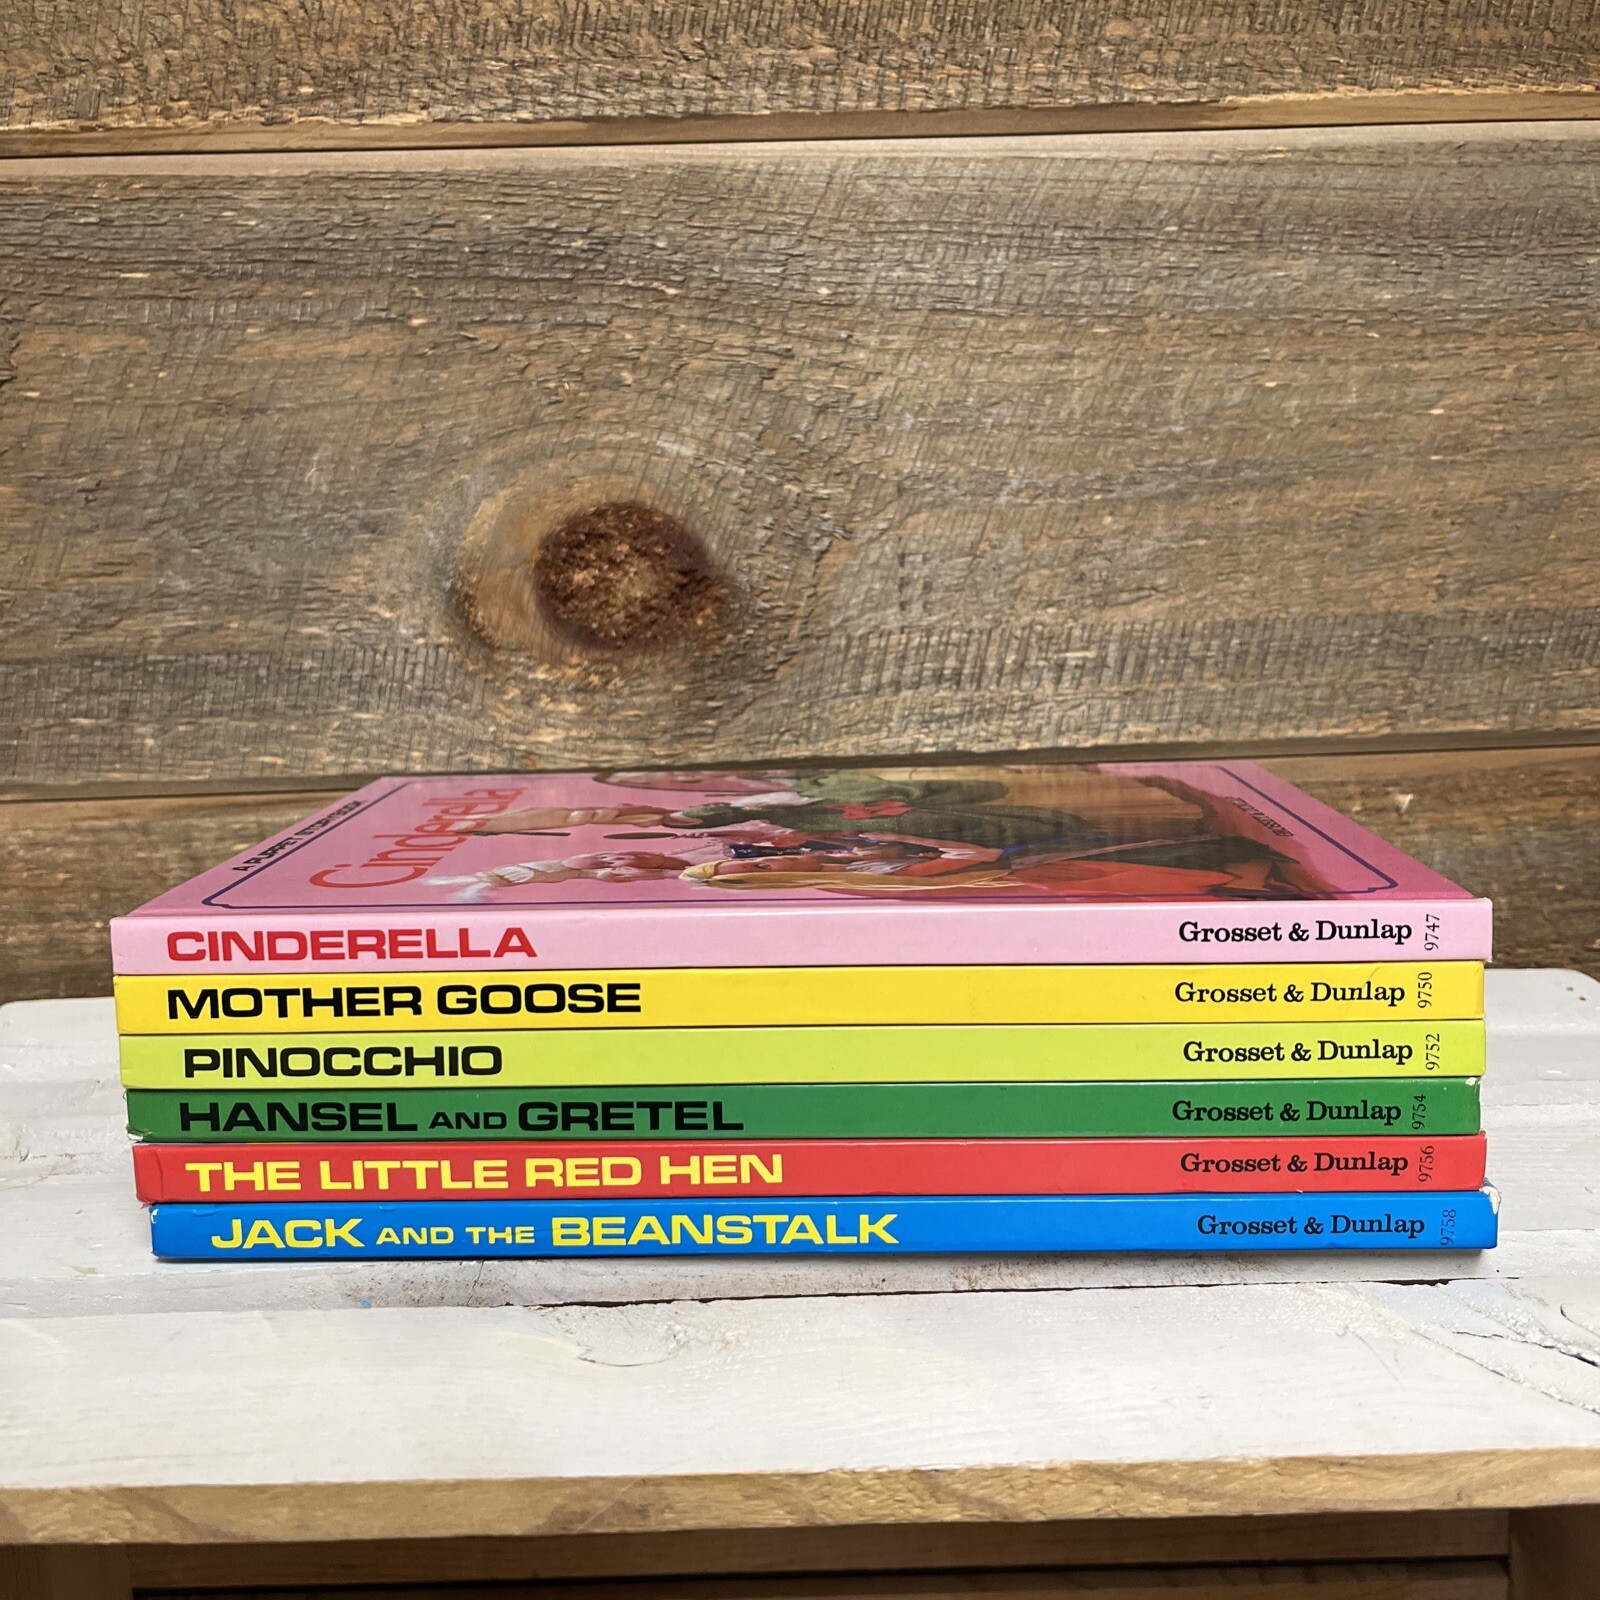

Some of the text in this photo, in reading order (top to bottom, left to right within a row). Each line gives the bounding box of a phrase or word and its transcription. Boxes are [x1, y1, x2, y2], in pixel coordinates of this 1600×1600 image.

[243, 836, 303, 864] PUPPET
[309, 788, 526, 888] Cinderella
[232, 864, 255, 872] A
[167, 927, 537, 961] CINDERELLA
[1179, 919, 1412, 946] Grosset & Dunlap
[1424, 913, 1440, 951] 9747
[168, 982, 641, 1019] MOTHER GOOSE
[1175, 980, 1405, 1007] Grosset & Dunlap
[1417, 971, 1433, 1009] 9750
[185, 1045, 503, 1077] PINOCCHIO
[1184, 1038, 1413, 1065] Grosset & Dunlap
[1425, 1033, 1440, 1071] 9752
[180, 1100, 744, 1132] HANSEL AND GRETEL
[1172, 1099, 1401, 1126] Grosset & Dunlap
[1411, 1093, 1426, 1130] 9754
[186, 1153, 783, 1192] THE LITTLE RED HEN
[1180, 1151, 1409, 1177] Grosset & Dunlap
[1418, 1145, 1435, 1183] 9756
[211, 1213, 899, 1249] JACK AND THE BEANSTALK
[1197, 1213, 1424, 1239] Grosset & Dunlap
[1440, 1208, 1457, 1246] 9758
